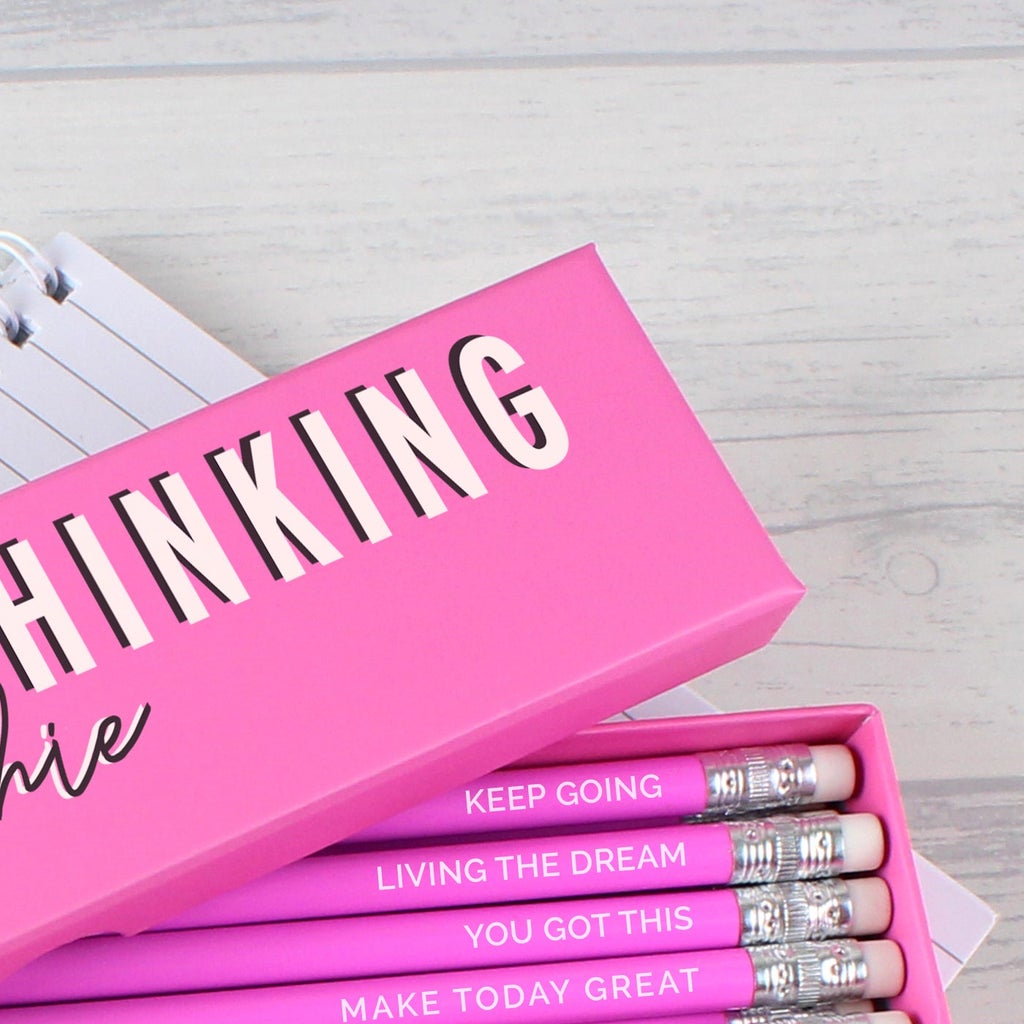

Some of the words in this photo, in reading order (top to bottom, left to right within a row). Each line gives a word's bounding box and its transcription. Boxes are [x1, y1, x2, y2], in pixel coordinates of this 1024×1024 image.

[464, 783, 547, 815] KEEP
[555, 774, 663, 807] GOING
[376, 858, 487, 891] LIVING
[493, 852, 561, 881] THE
[571, 842, 687, 875] DREAM
[463, 919, 534, 949] YOU
[543, 912, 611, 942] GOT
[618, 905, 694, 935] THIS
[340, 990, 439, 1023] MAKE
[452, 979, 572, 1015] TODAY
[584, 967, 700, 1001] GREAT
